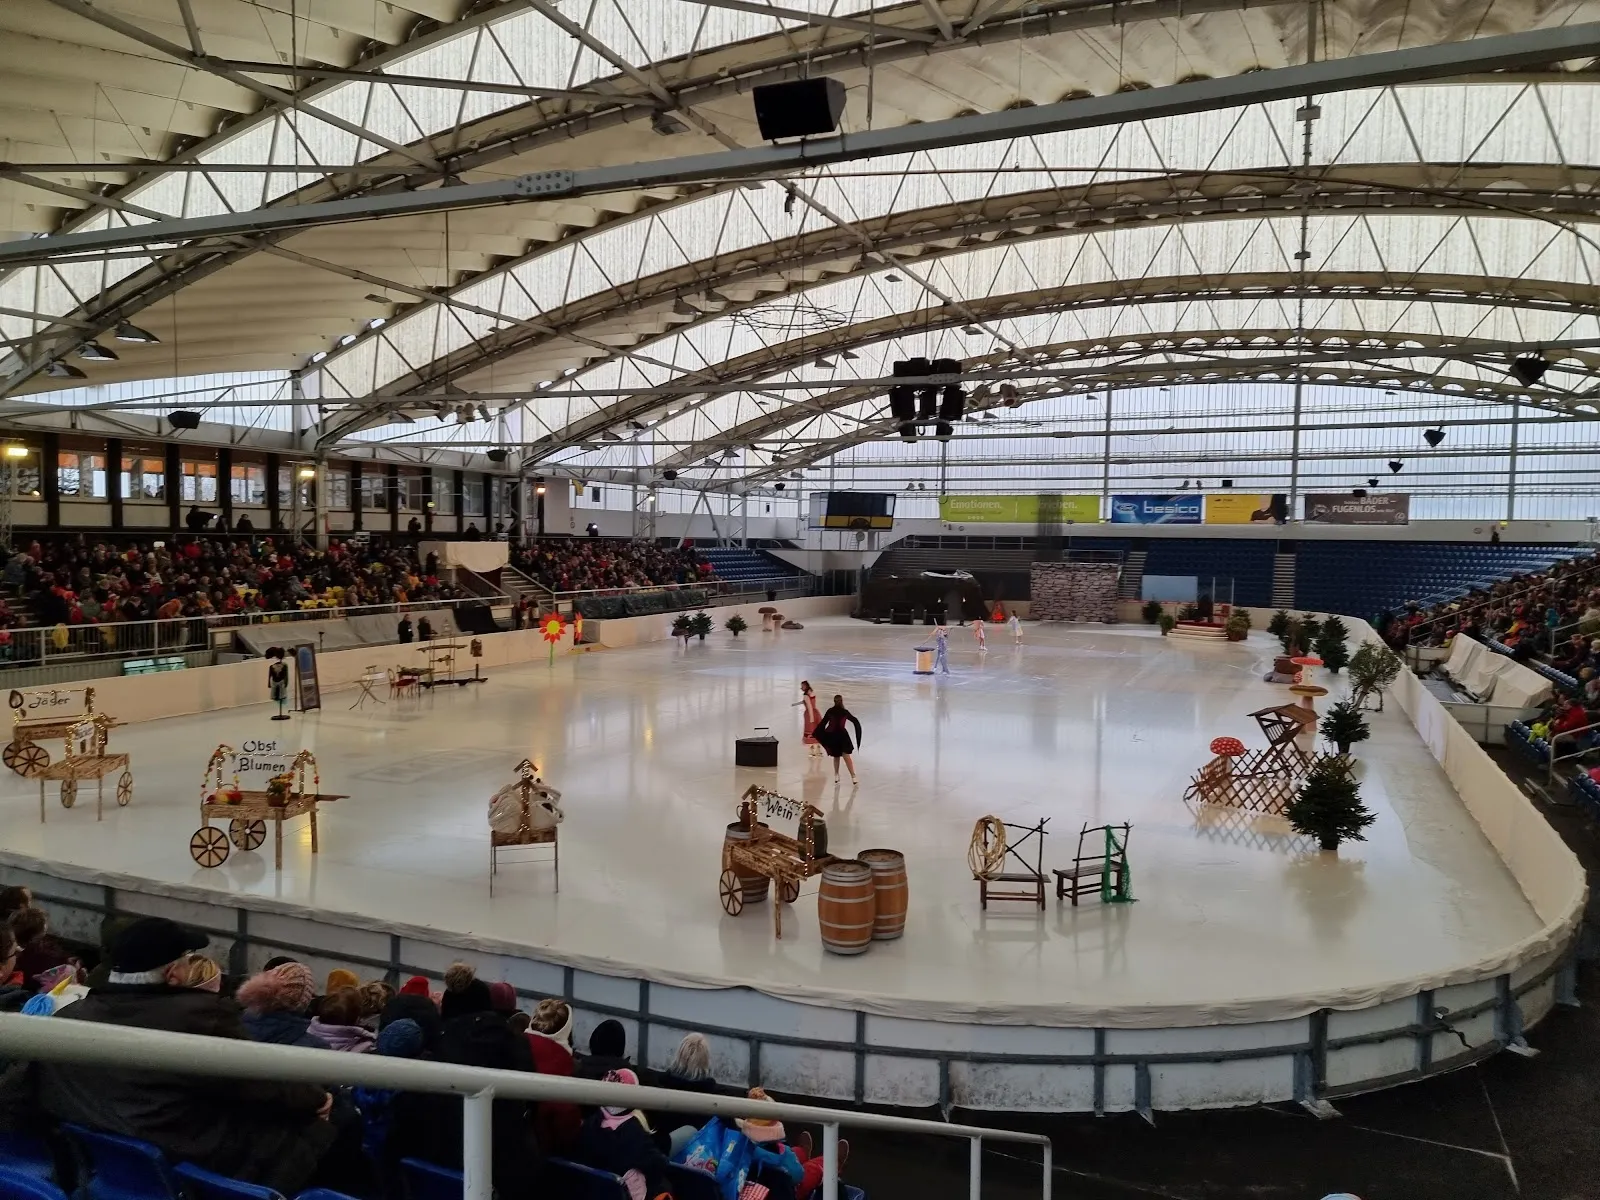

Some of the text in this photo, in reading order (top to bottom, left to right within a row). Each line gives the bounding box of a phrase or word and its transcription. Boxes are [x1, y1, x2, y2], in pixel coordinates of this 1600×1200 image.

[950, 499, 1003, 509] Emotionen.
[1143, 500, 1200, 514] besico
[1332, 505, 1376, 513] FUGENLOS
[28, 696, 71, 709] Jäger
[242, 740, 277, 753] Obst
[238, 757, 286, 772] Blumen
[766, 794, 794, 821] Wein
